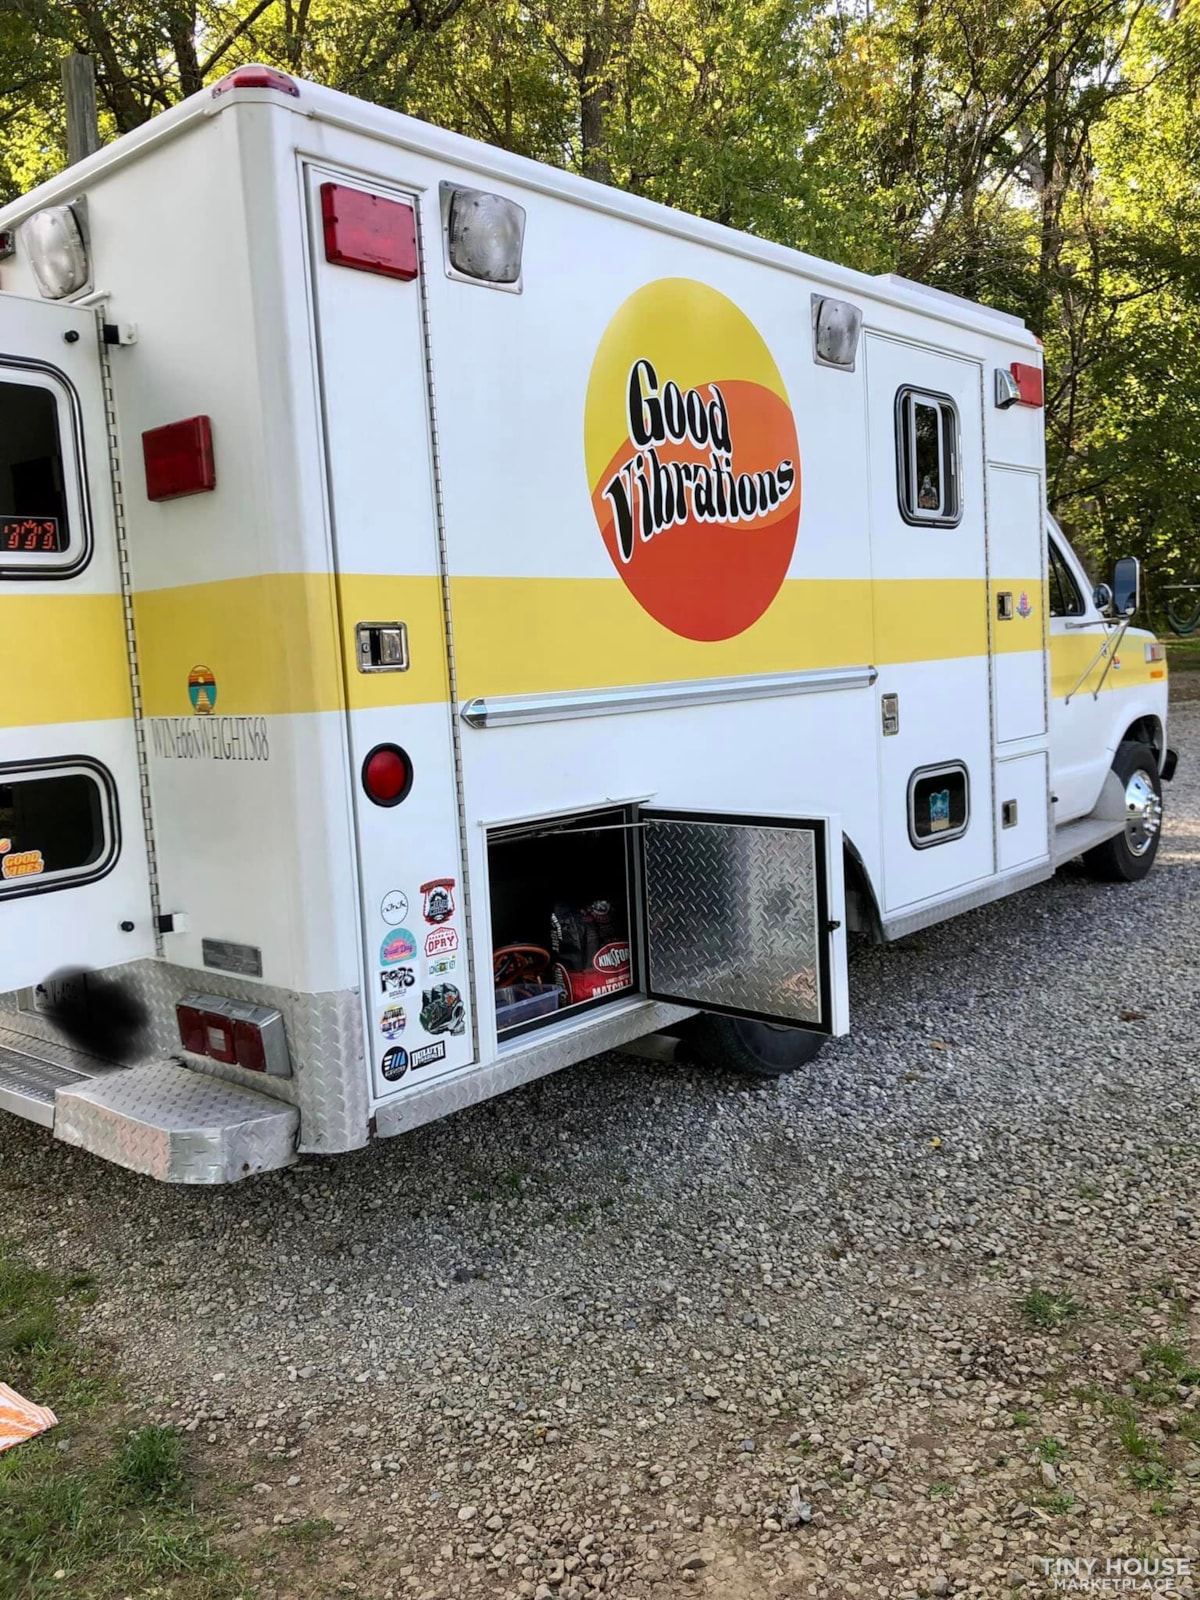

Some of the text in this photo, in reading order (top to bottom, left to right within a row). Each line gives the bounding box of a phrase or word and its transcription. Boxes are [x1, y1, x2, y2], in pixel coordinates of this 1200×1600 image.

[627, 358, 733, 455] Good
[602, 447, 795, 563] Vibrations
[4, 852, 40, 866] GOOD
[4, 862, 42, 877] VIBES
[428, 936, 455, 952] OPRY
[411, 1043, 444, 1067] DULUTH
